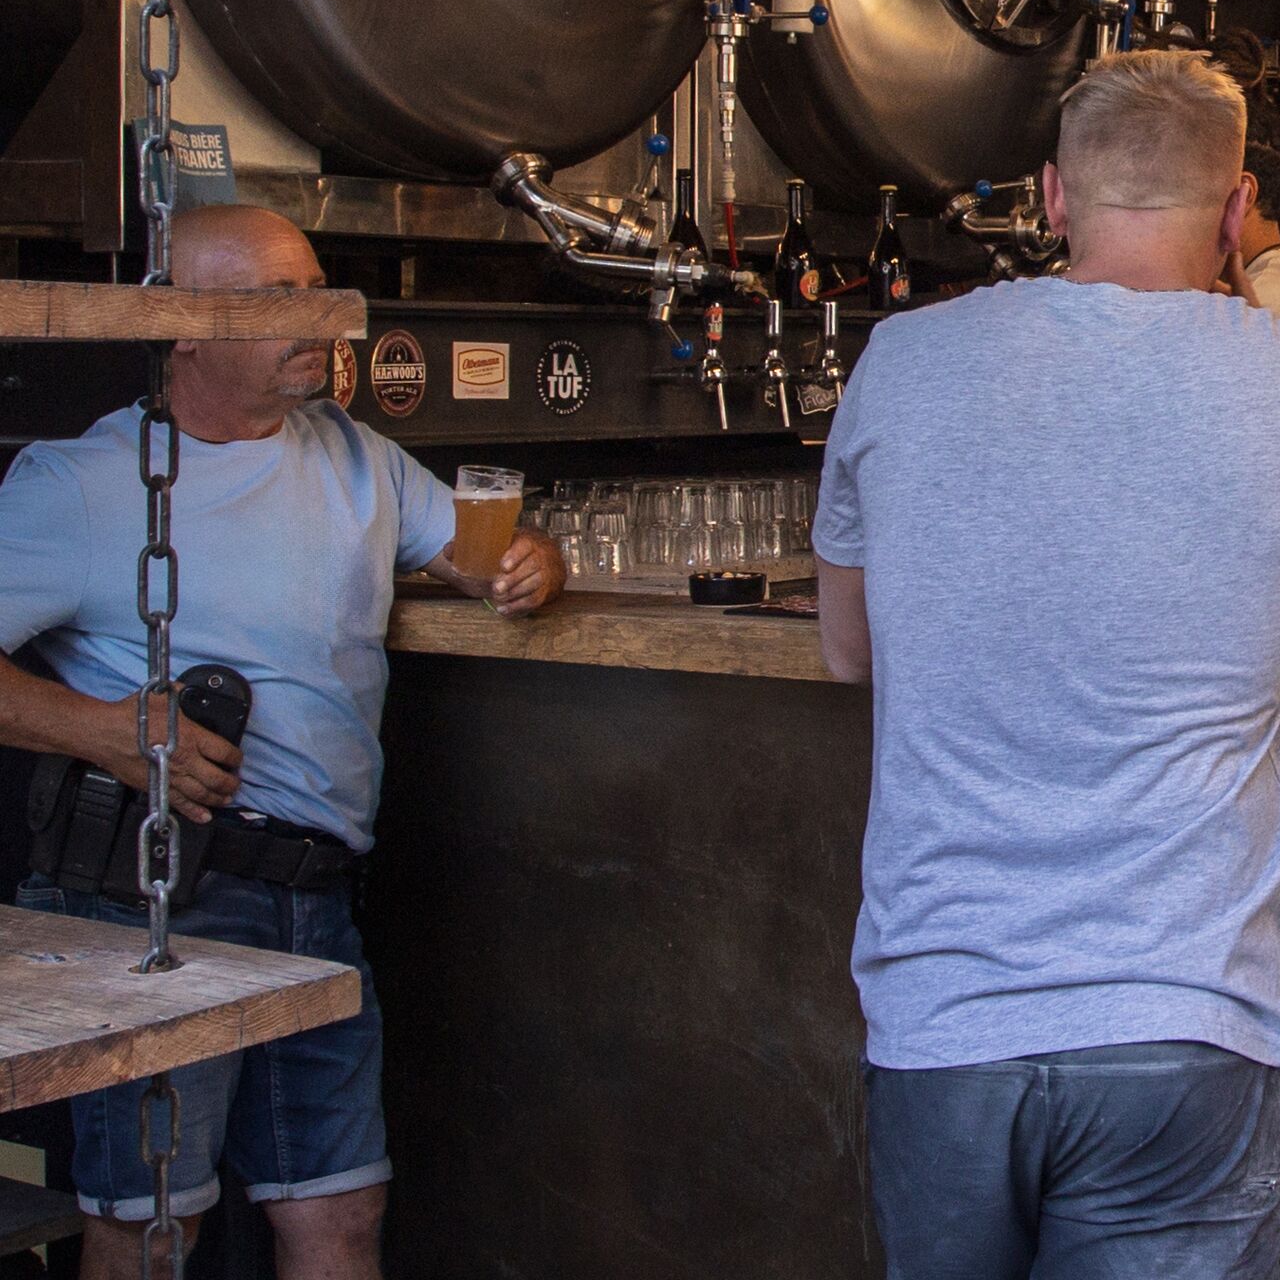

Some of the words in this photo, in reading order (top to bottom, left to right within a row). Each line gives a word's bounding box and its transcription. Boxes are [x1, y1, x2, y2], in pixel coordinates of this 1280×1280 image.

[190, 132, 223, 149] BIÈRE
[375, 366, 423, 380] HARWOOD'S
[553, 353, 578, 376] LA
[381, 386, 405, 397] PORTER
[405, 387, 418, 396] ALE
[547, 375, 583, 399] TUF
